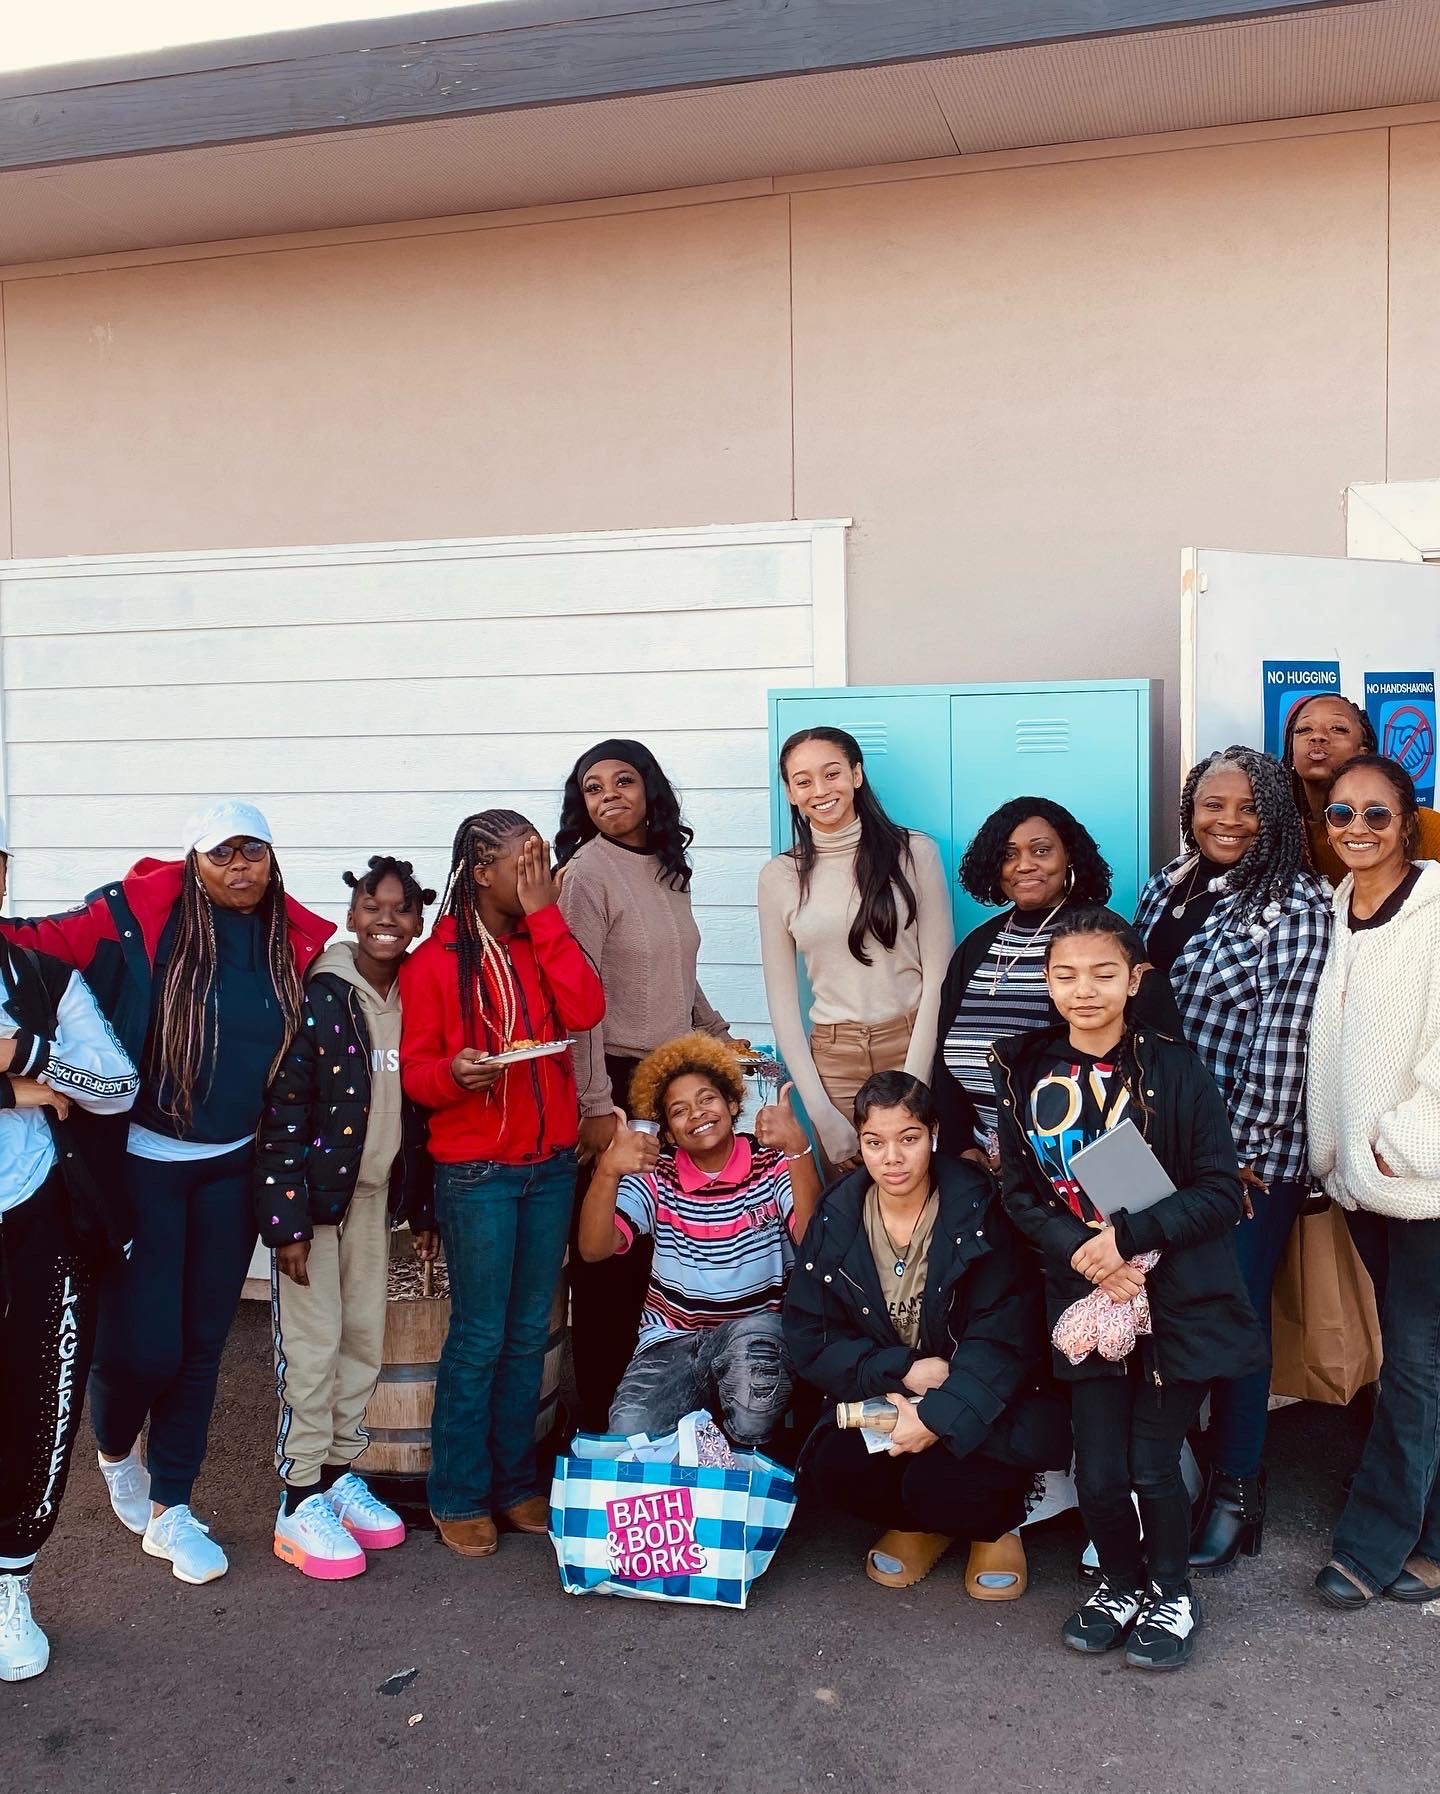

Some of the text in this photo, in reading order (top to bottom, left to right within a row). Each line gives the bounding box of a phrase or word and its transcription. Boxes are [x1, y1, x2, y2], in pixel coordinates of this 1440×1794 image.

[1267, 671, 1336, 684] NO HUGGING
[1366, 683, 1434, 693] NO HANDSHAKING
[612, 1492, 685, 1529] BATH
[606, 1517, 697, 1557] & BODY
[607, 1543, 708, 1577] WORKS
